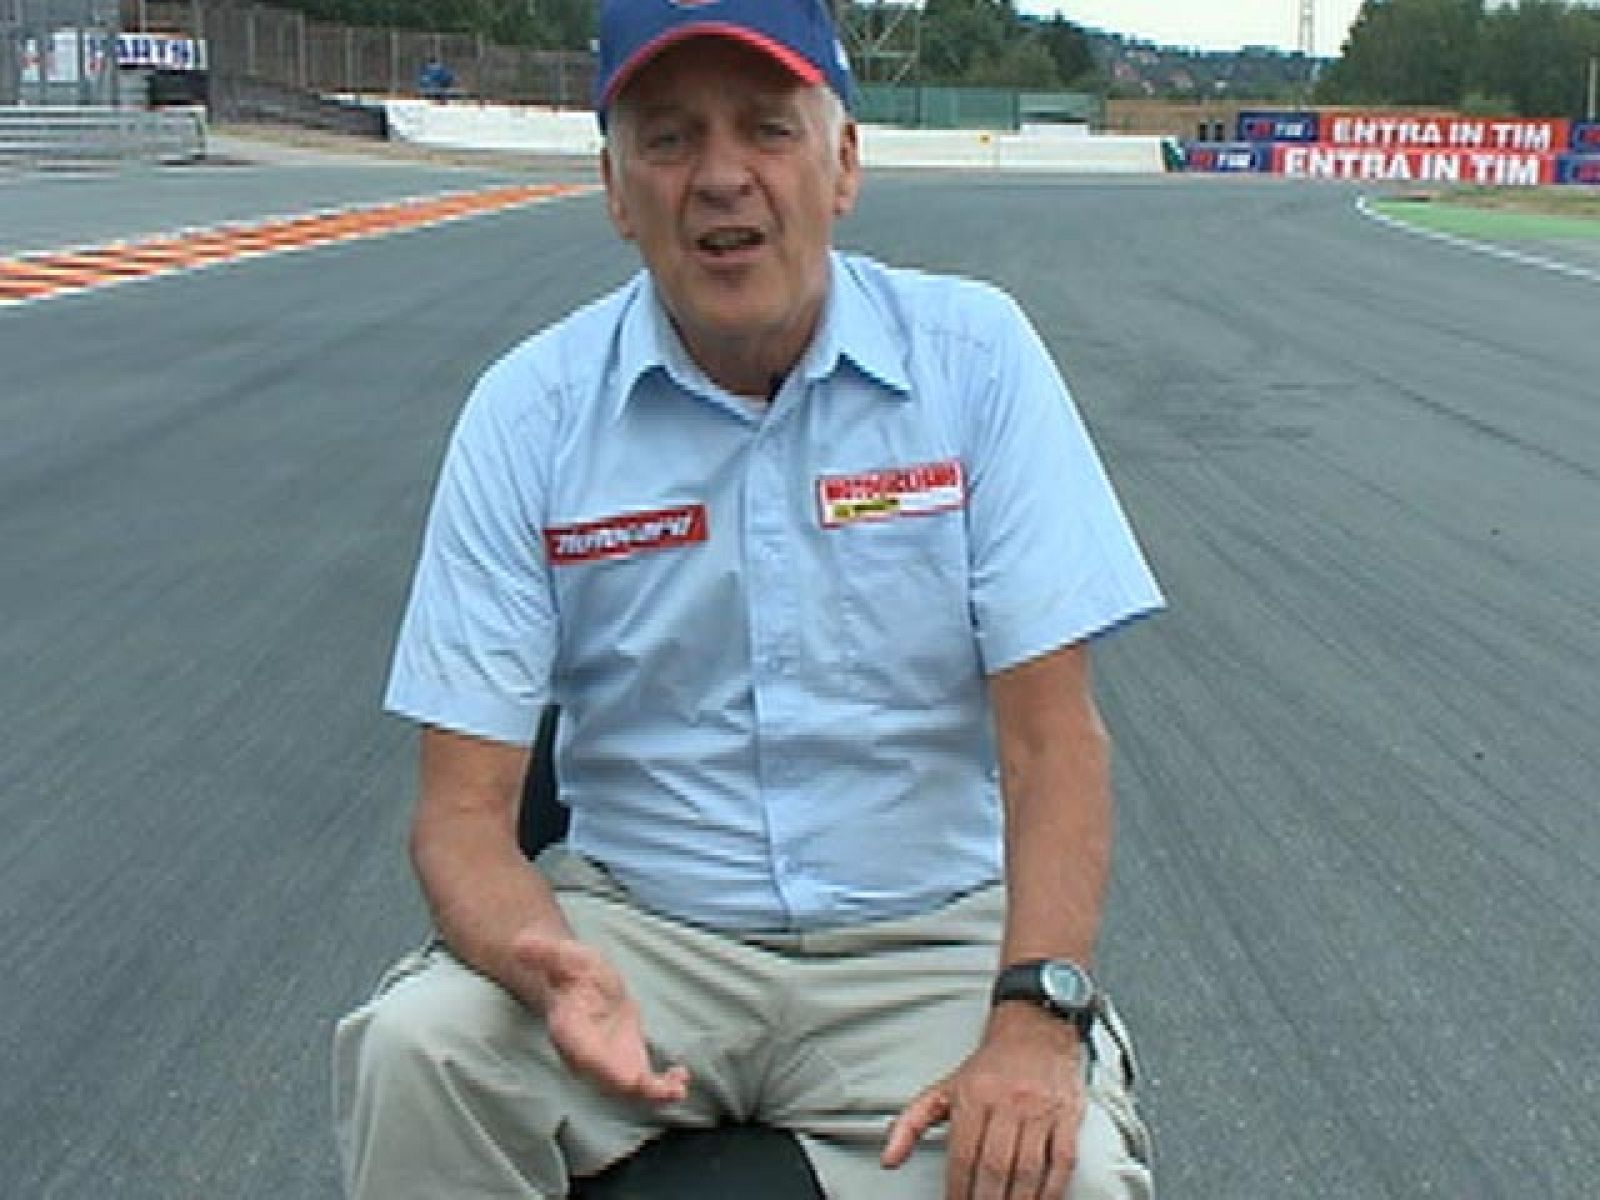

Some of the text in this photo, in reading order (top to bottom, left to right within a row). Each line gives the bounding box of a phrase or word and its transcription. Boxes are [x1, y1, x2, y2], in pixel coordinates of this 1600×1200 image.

[1332, 115, 1552, 150] ENTRA IN TIM
[1284, 147, 1540, 185] ENTRA IN TIM
